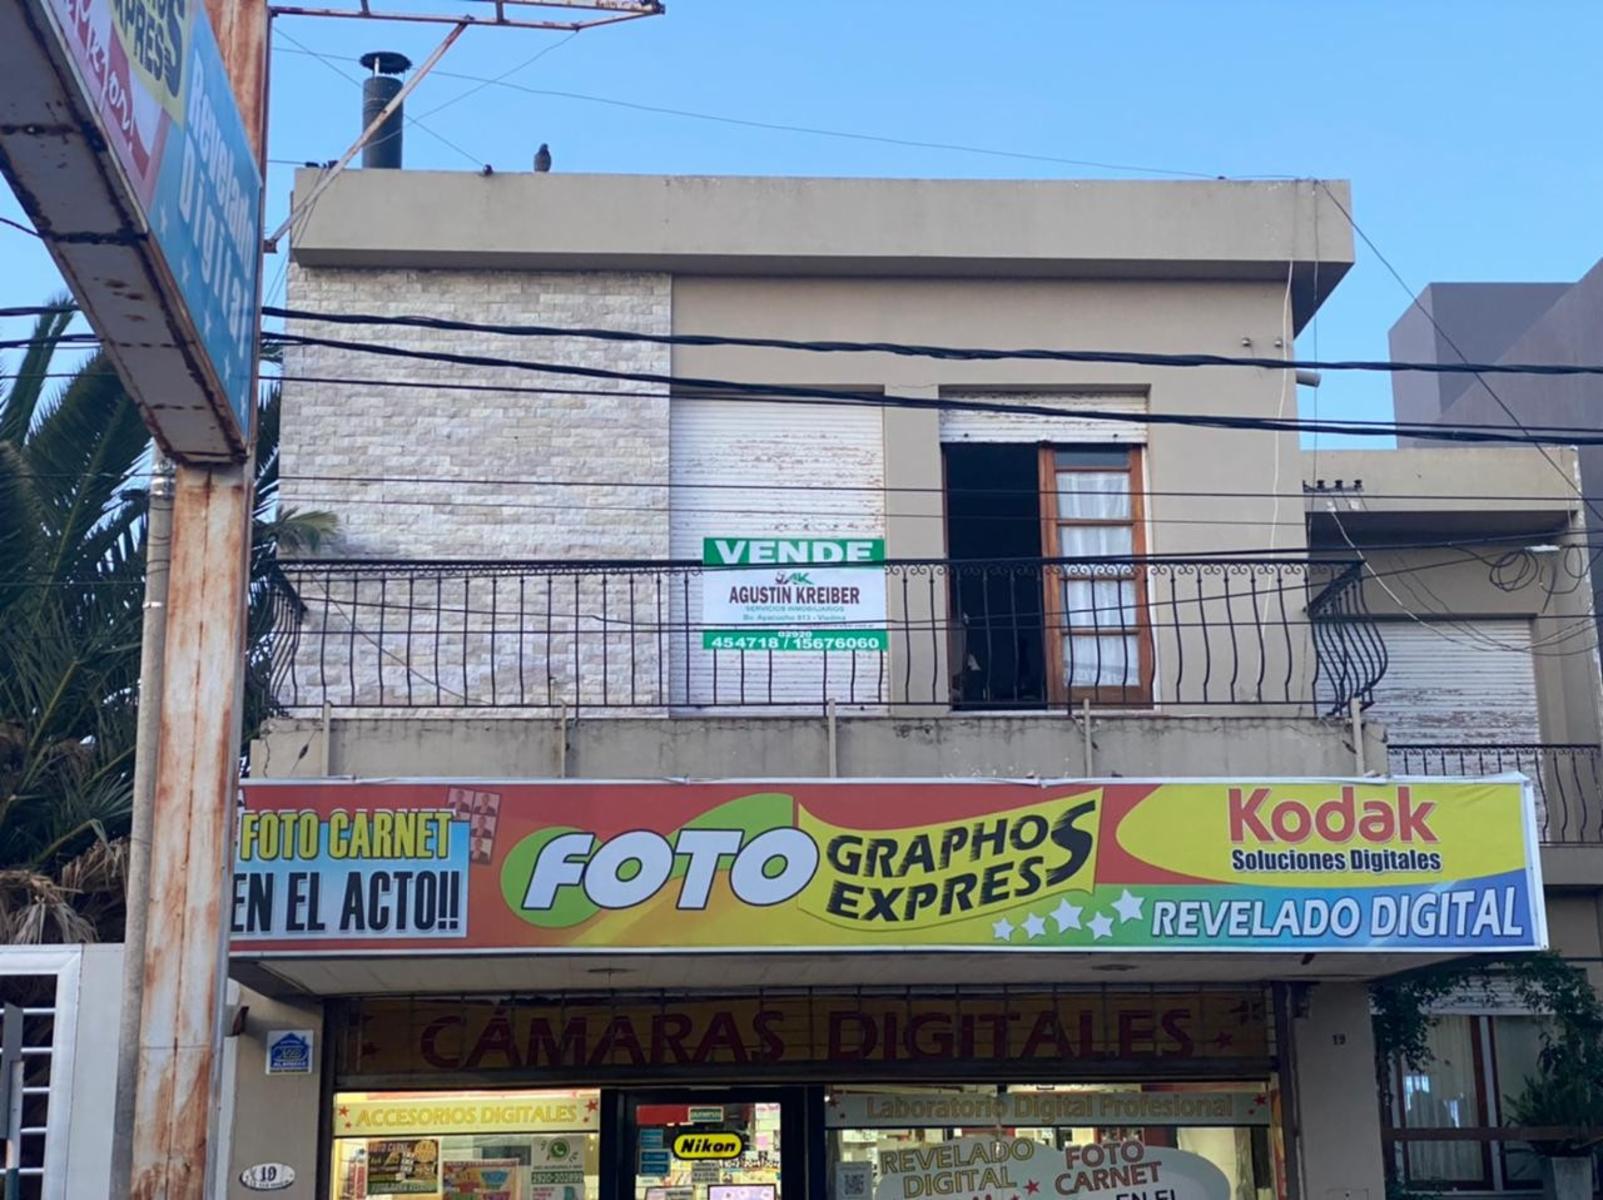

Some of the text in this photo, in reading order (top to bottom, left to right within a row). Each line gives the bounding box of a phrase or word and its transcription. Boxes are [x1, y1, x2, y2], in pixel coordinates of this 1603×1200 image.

[188, 48, 254, 281] Revelado
[179, 132, 250, 359] Digital
[715, 540, 873, 564] VENDE
[729, 586, 860, 604] AGUSTIN KREIBER
[711, 637, 779, 649] 454718
[793, 637, 880, 649] 15676060
[1228, 786, 1439, 845] Kodak
[240, 808, 456, 861] FOTO CARNET
[520, 826, 820, 910] FOTO
[1231, 849, 1442, 873] Soluciones Digitales
[231, 870, 459, 931] EN EL ACTO!!
[1151, 886, 1525, 938] REVELADO DIGITAL
[420, 1007, 1194, 1068] CÁMARAS DIGITALES
[356, 1104, 578, 1127] ACCESORIOS DIGITALES
[866, 1094, 1232, 1124] Laboratorio Digital Profesional
[681, 1138, 736, 1153] Nikon
[880, 1137, 1035, 1175] REVELADO
[1065, 1140, 1145, 1169] FOTO
[903, 1166, 1018, 1199] DIGITAL
[1055, 1161, 1162, 1196] CARNET
